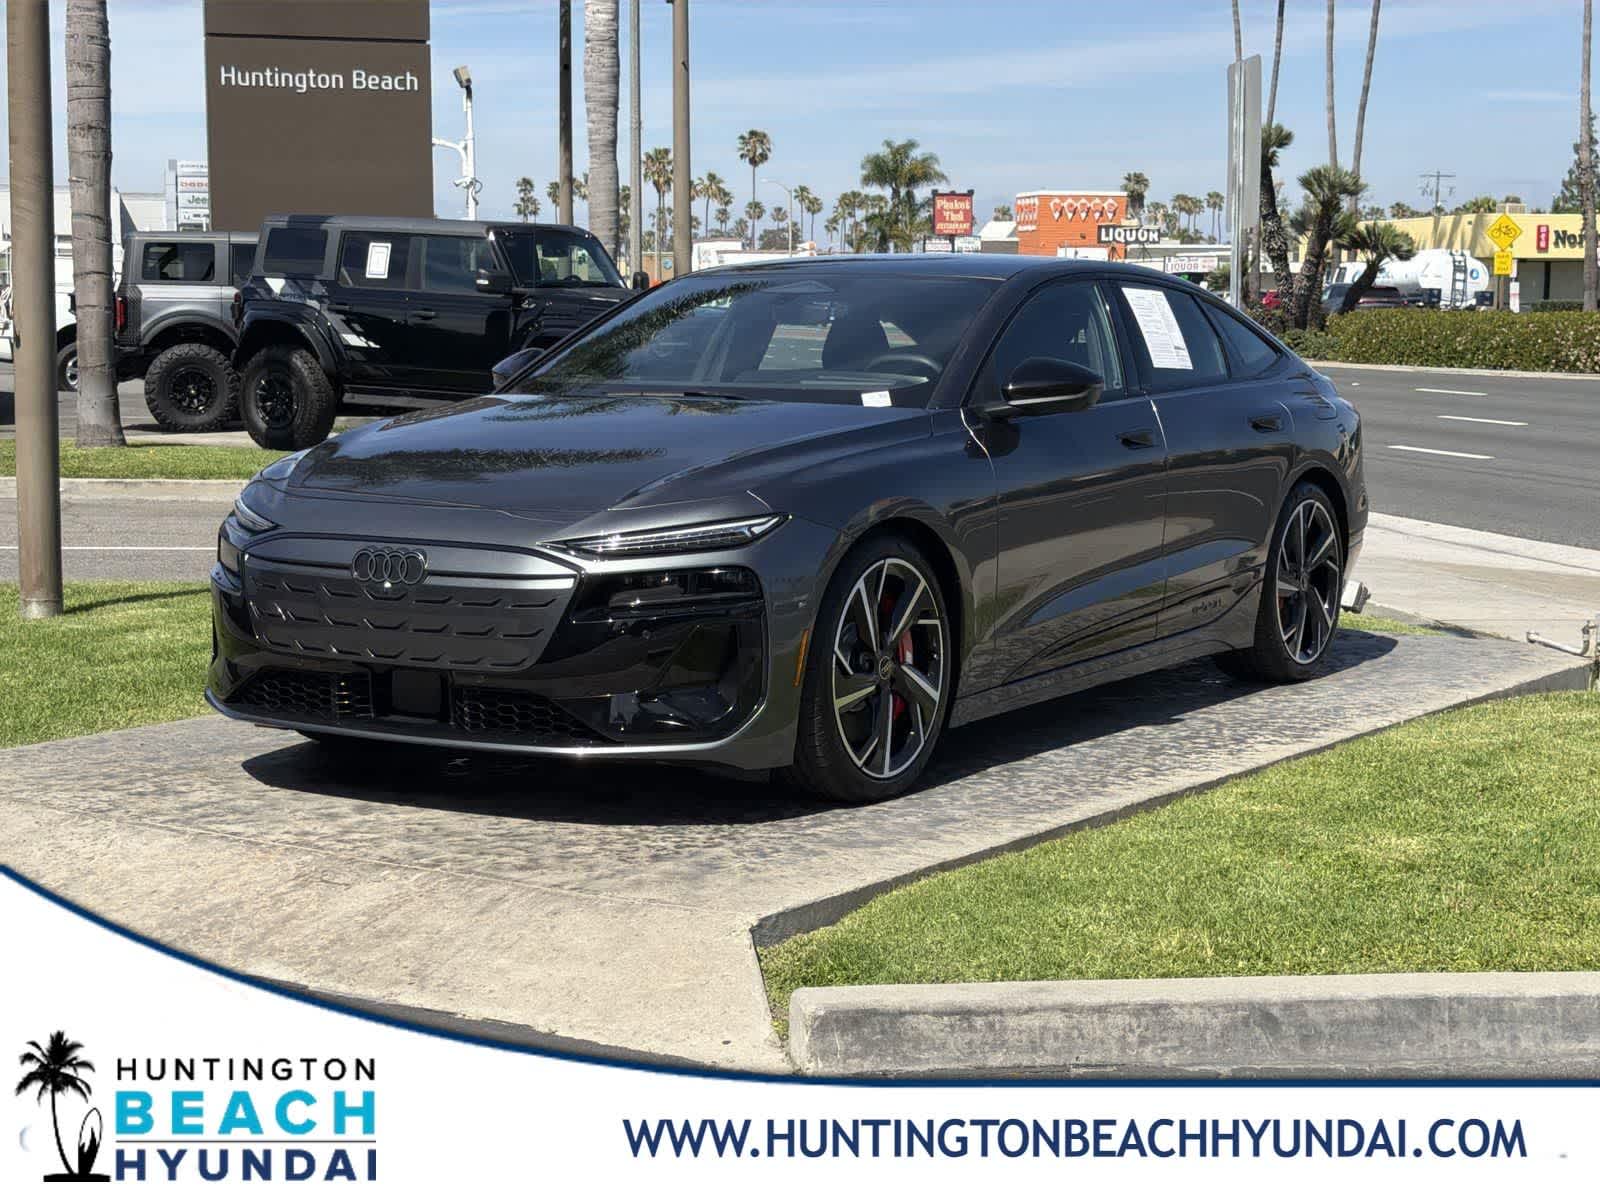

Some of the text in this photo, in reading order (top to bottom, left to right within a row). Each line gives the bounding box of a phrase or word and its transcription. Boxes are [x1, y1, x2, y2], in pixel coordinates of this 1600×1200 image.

[220, 65, 418, 93] Huntington Beach
[188, 195, 208, 204] Jee
[1100, 227, 1159, 243] LIQUOR
[1553, 230, 1585, 248] Nor
[1165, 262, 1199, 273] LIQUOR
